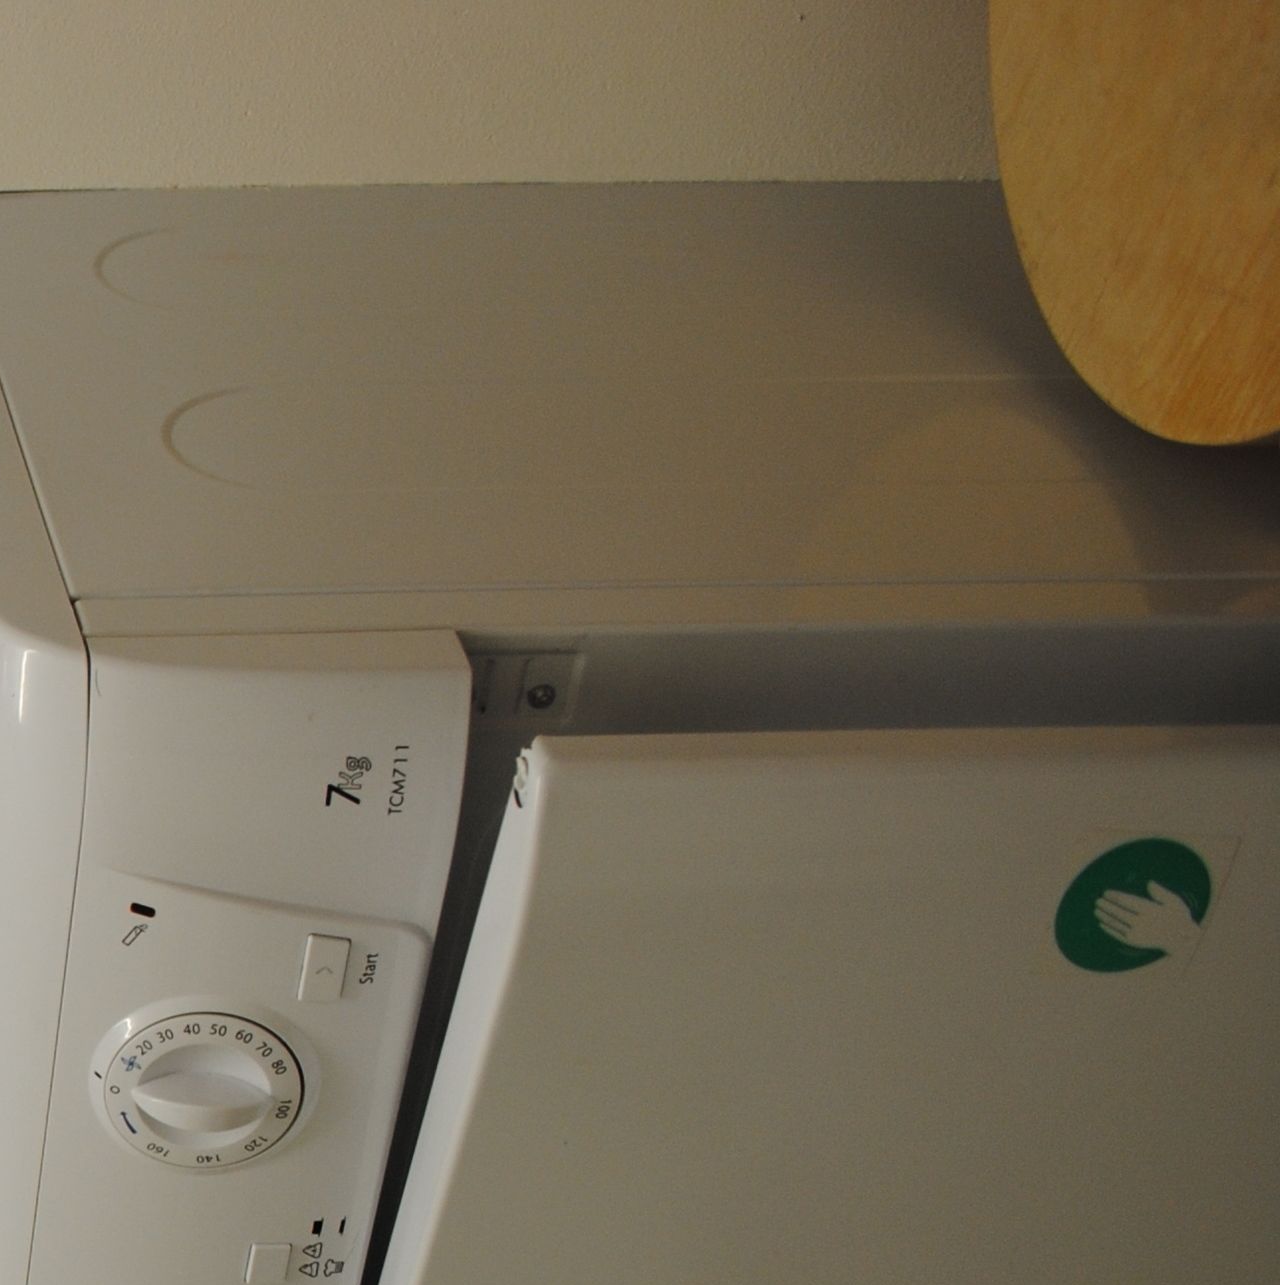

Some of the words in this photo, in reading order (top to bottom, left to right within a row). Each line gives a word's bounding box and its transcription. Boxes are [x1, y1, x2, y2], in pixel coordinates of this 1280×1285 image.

[388, 743, 410, 815] TCM711
[358, 952, 380, 985] Start
[156, 1029, 175, 1043] 30
[182, 1023, 201, 1036] 40
[209, 1023, 228, 1037] 50
[234, 1029, 254, 1045] 60
[135, 1039, 153, 1056] 20
[254, 1040, 274, 1058] 70
[271, 1059, 288, 1076] 80
[274, 1099, 293, 1120] 100
[146, 1142, 171, 1158] 160
[243, 1134, 269, 1152] 120
[195, 1154, 221, 1165] 140
